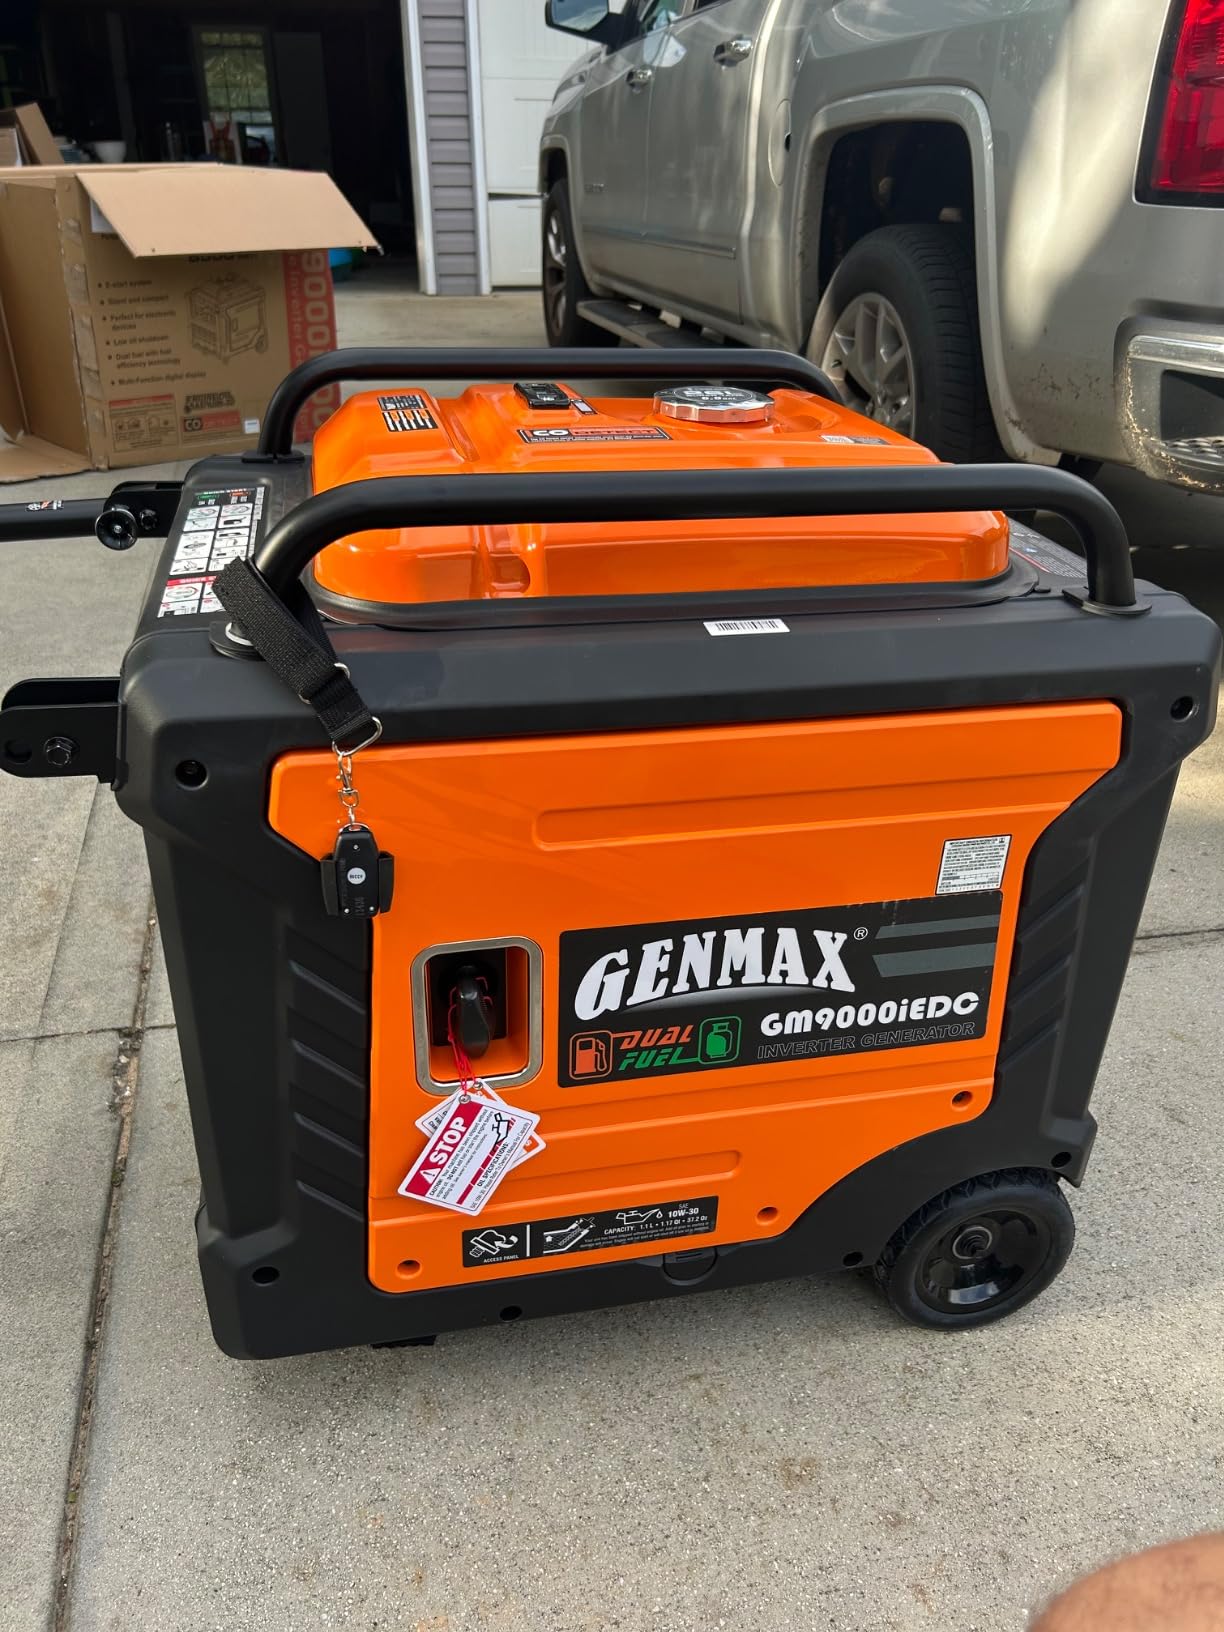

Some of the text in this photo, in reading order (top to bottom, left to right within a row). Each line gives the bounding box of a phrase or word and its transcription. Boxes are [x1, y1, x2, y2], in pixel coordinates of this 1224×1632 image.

[574, 927, 856, 1021] GENMAX
[760, 991, 979, 1037] GM9000iEDC
[617, 1024, 694, 1050] DUAL
[757, 1021, 975, 1060] INVERTER GENERATOR
[618, 1046, 688, 1071] FUEL
[429, 1116, 469, 1165] STOP
[450, 1166, 458, 1174] NOT
[476, 1141, 509, 1186] OIL SPECIFICATIONS:
[668, 1207, 699, 1218] 10W-30
